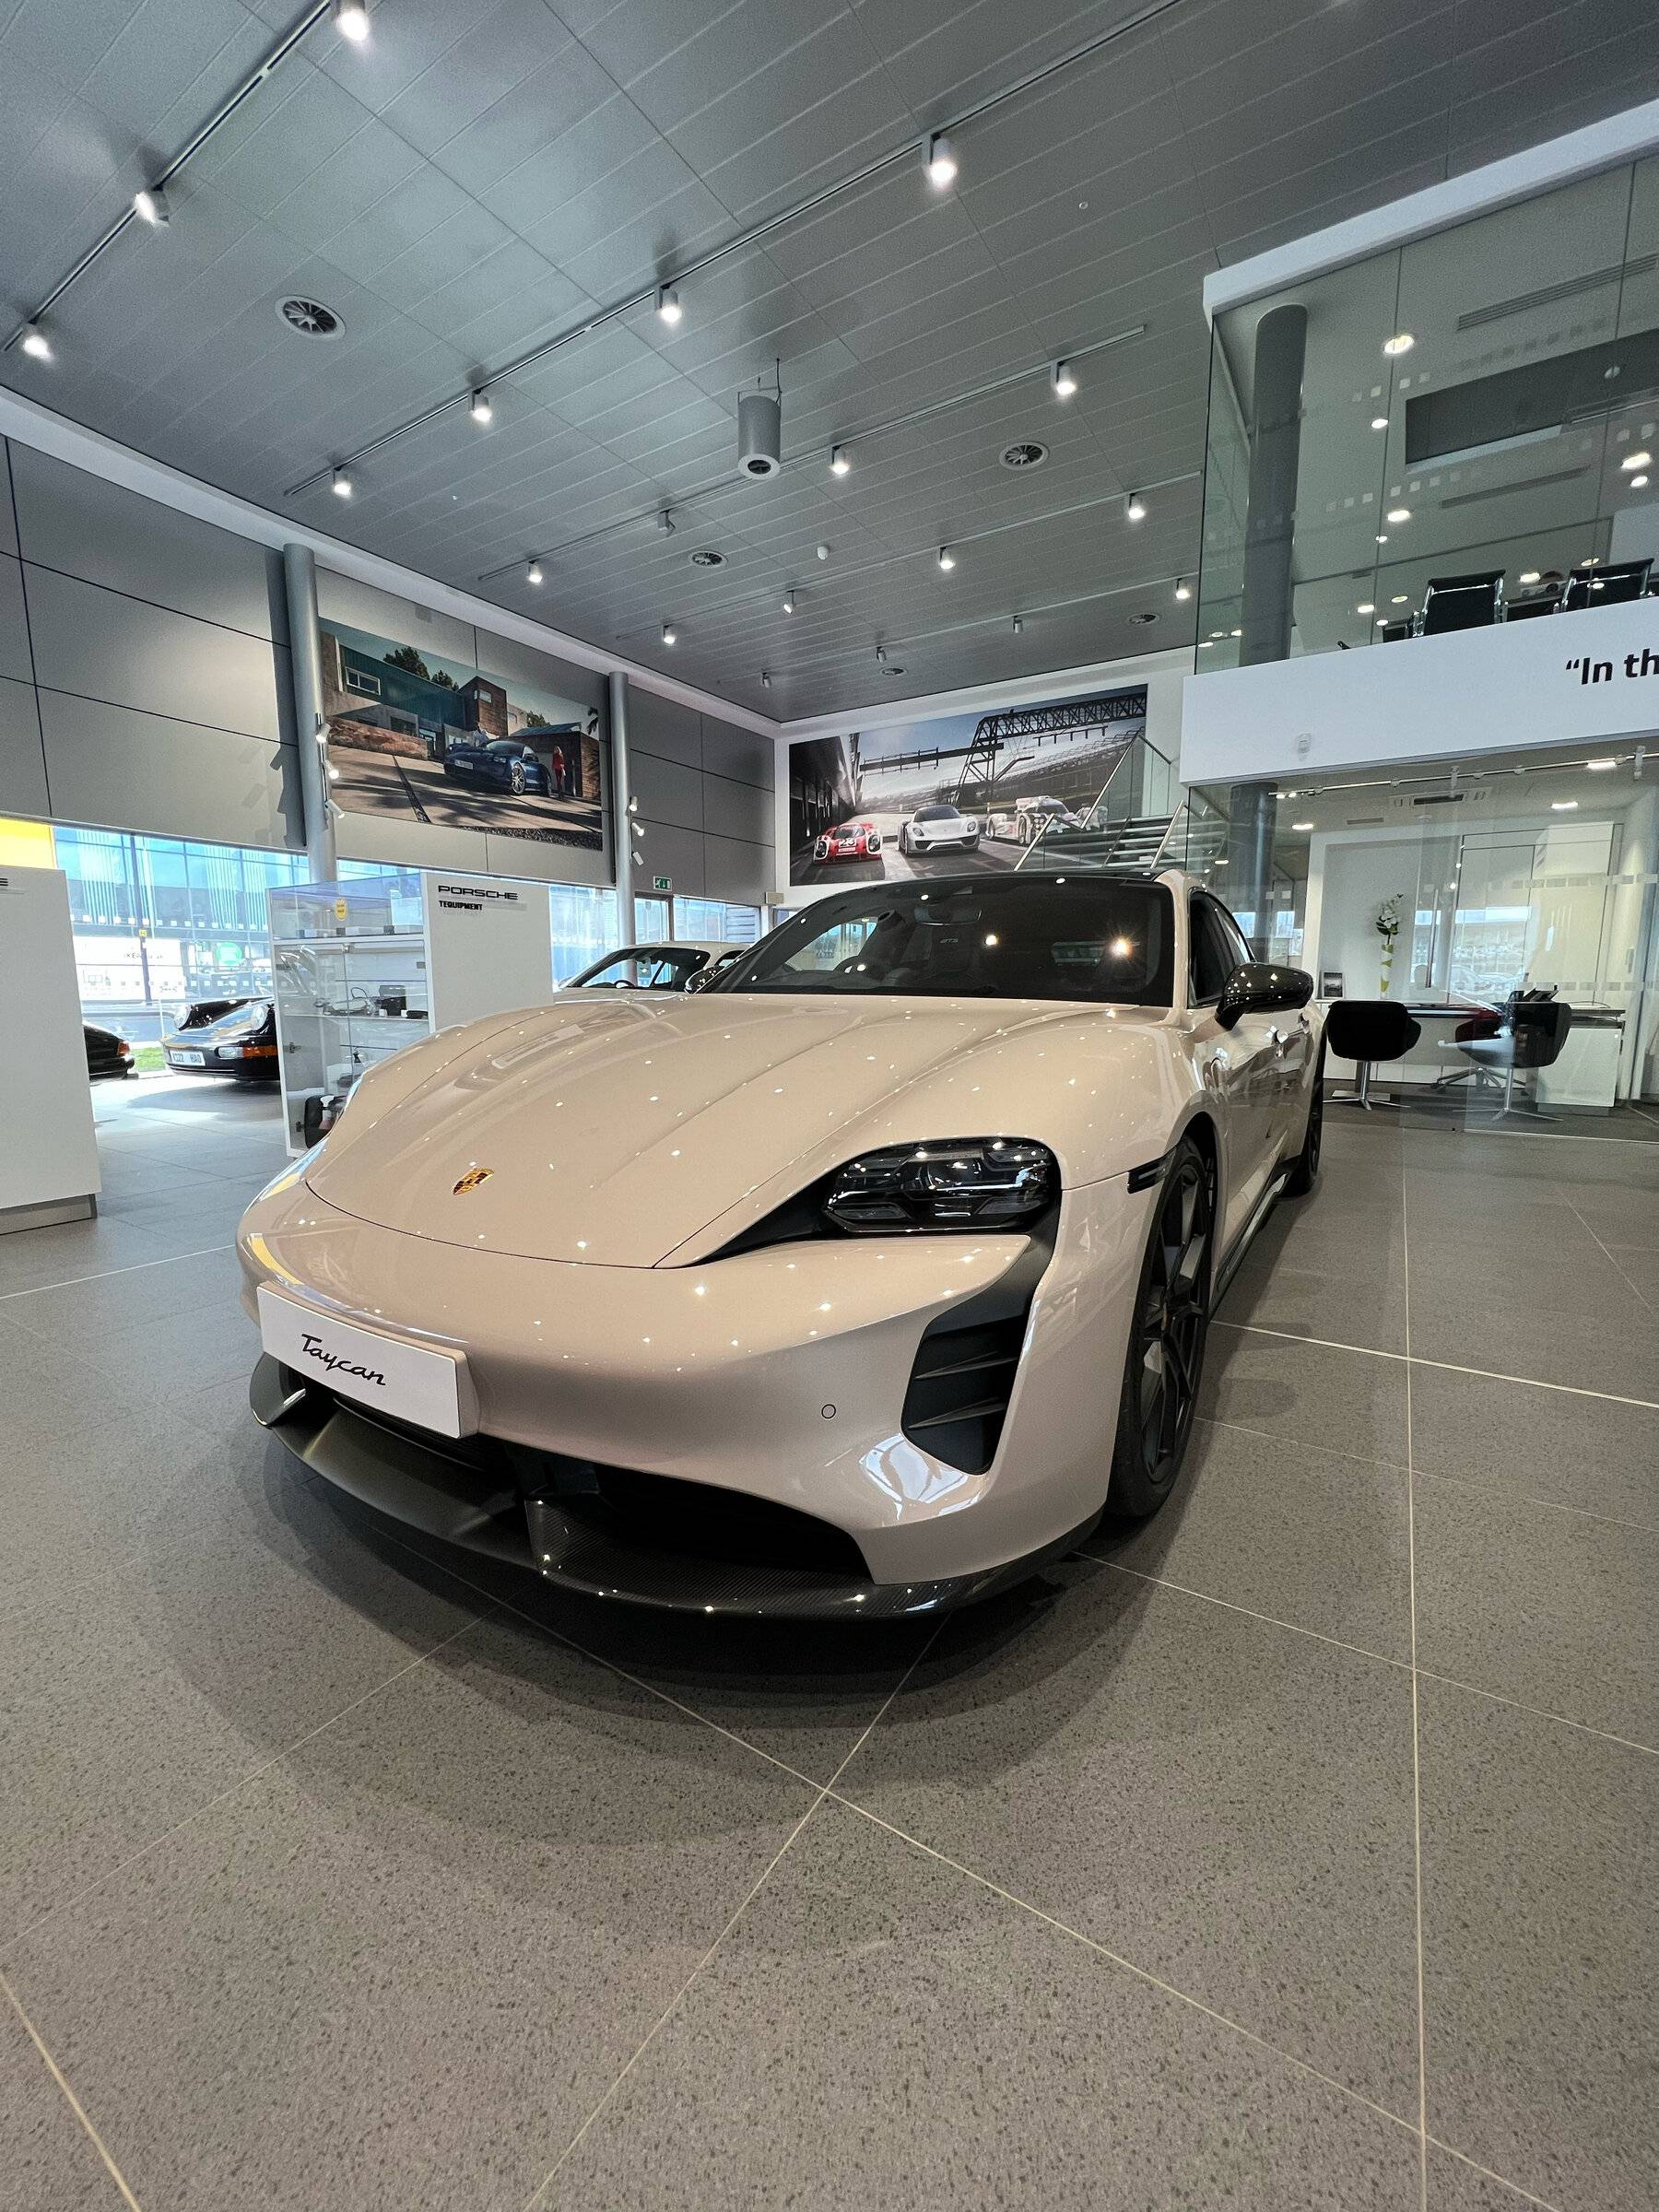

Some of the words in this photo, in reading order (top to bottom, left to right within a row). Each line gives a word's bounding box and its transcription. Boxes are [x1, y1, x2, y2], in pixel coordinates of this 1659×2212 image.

[438, 885, 518, 900] PORSCHE
[439, 900, 483, 911] TEQUIPMENT
[301, 1334, 386, 1385] Taycan
